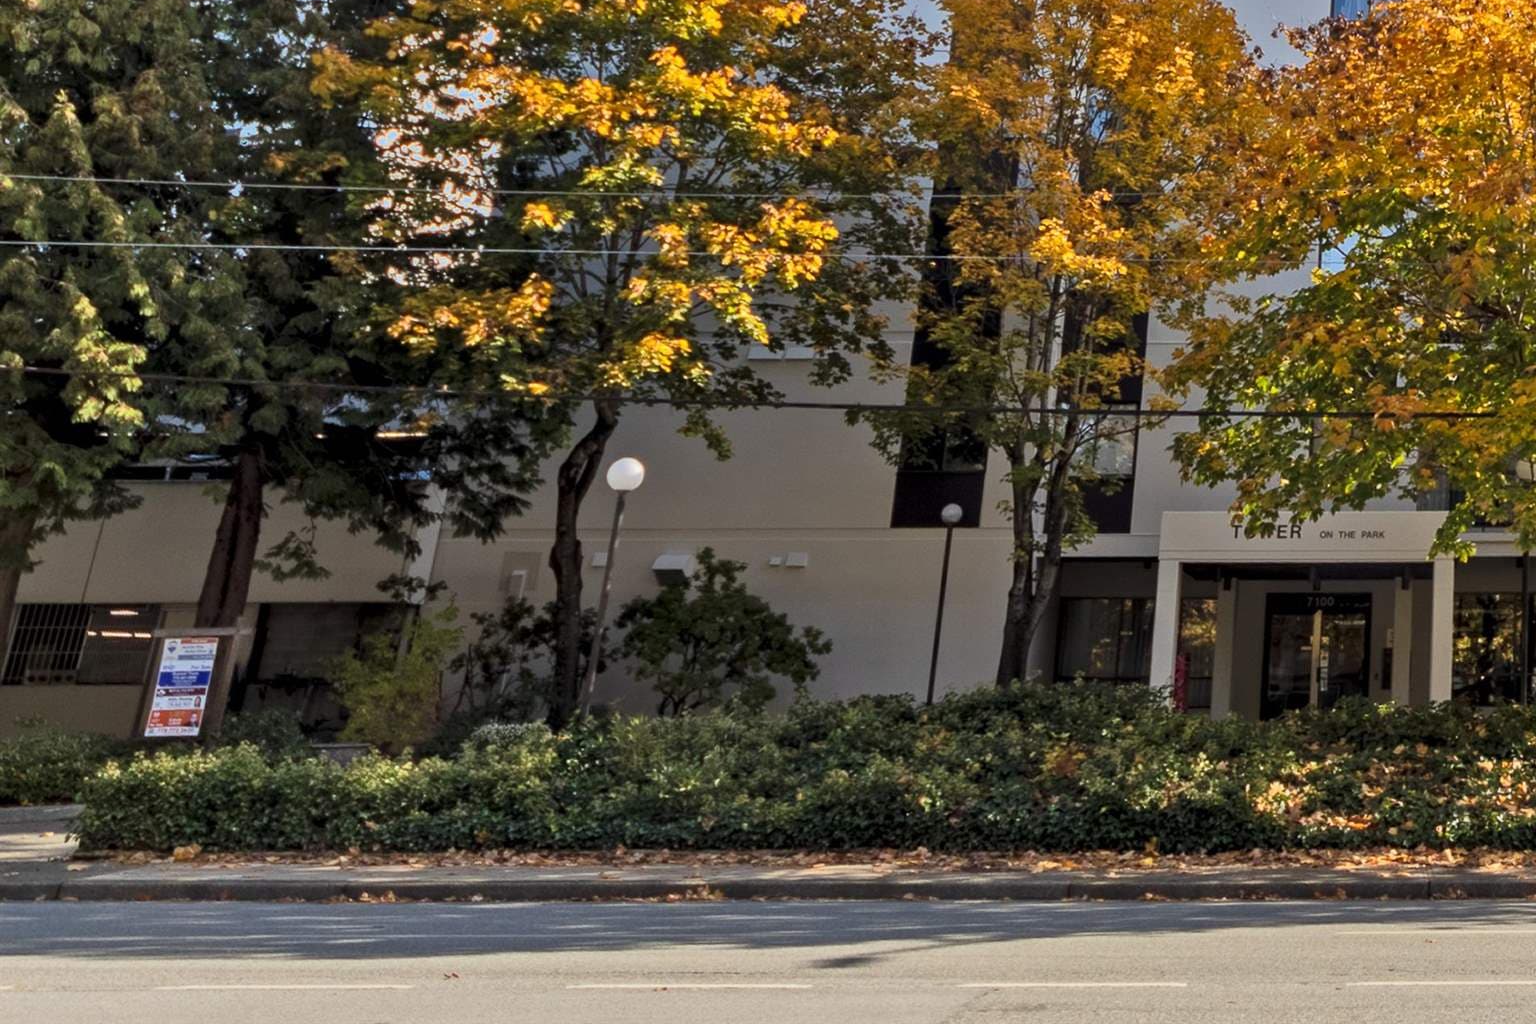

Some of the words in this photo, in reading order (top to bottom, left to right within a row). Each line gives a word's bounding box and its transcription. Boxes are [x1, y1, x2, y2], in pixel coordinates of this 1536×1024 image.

[1319, 530, 1334, 539] ON
[1339, 530, 1356, 539] THE
[1361, 530, 1385, 539] PARK
[1306, 596, 1335, 607] 7100
